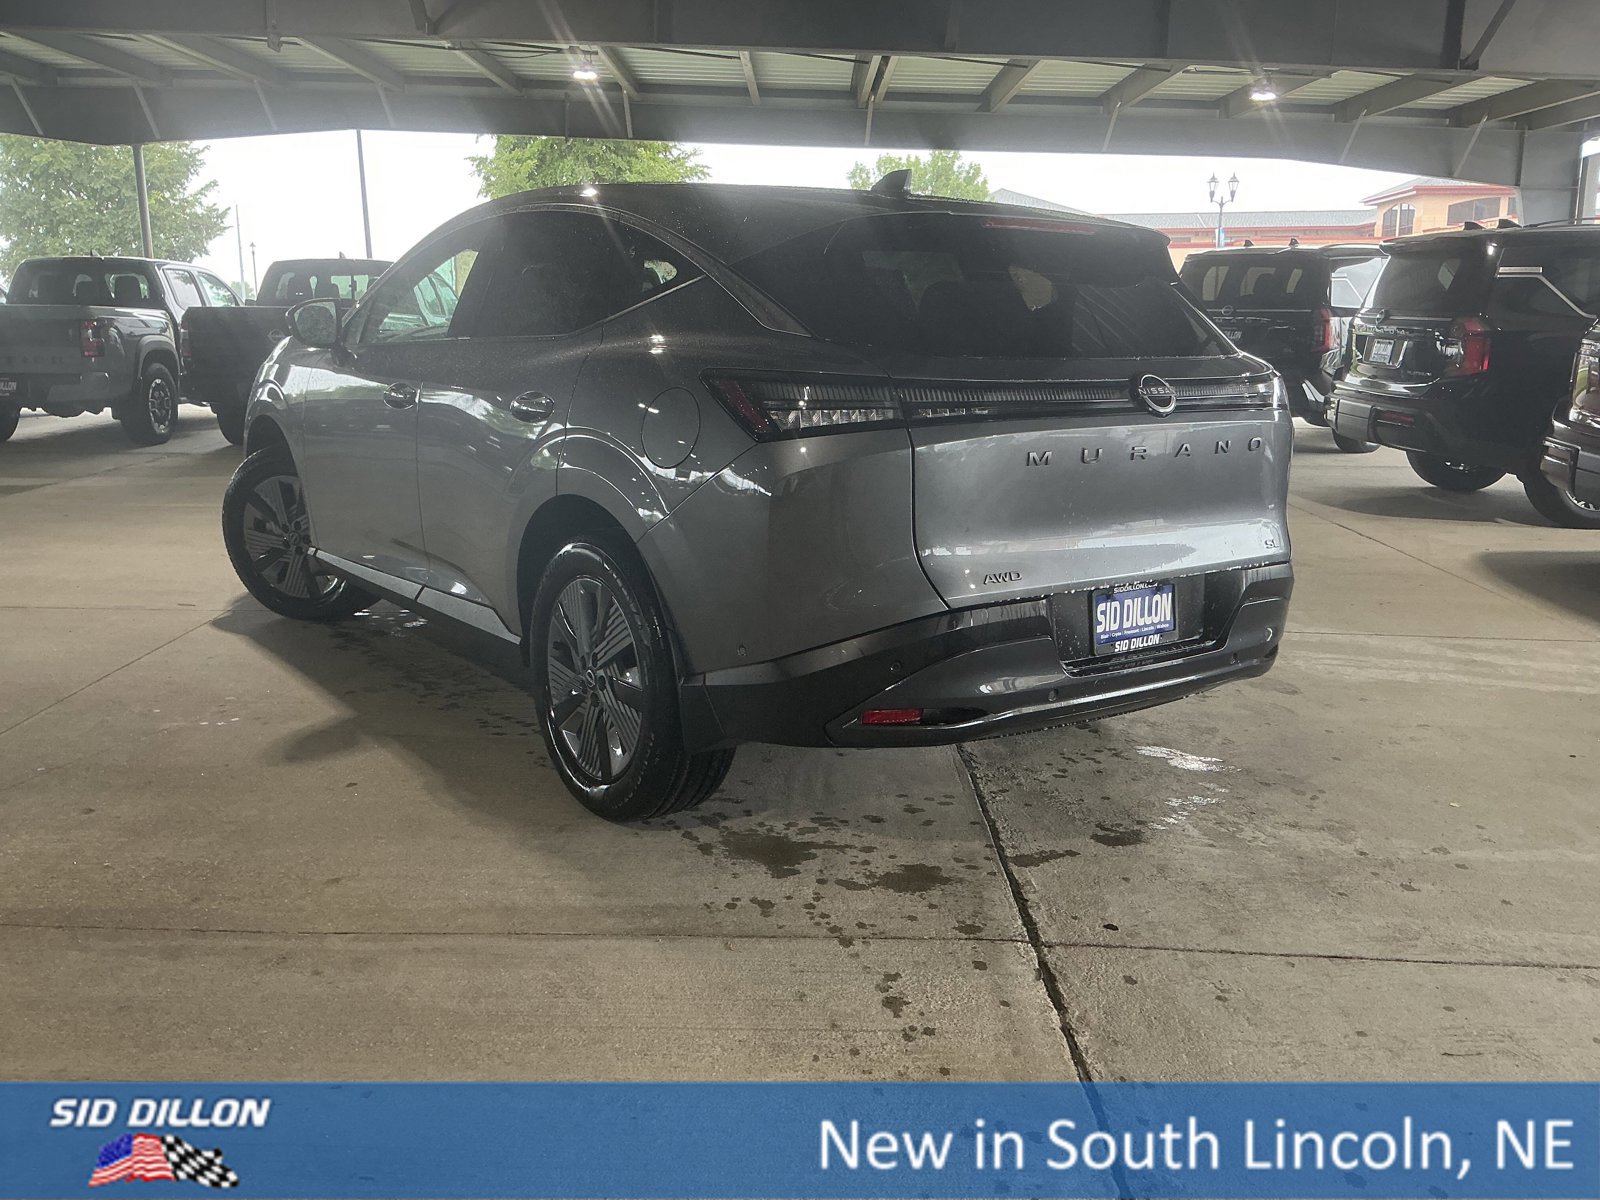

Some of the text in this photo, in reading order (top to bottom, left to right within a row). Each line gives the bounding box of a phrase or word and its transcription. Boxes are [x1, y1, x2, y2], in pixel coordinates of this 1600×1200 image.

[1025, 437, 1263, 467] MURANO
[983, 571, 1022, 584] AWD
[1096, 592, 1172, 633] SID DILLON
[1114, 633, 1160, 652] SID DILLON
